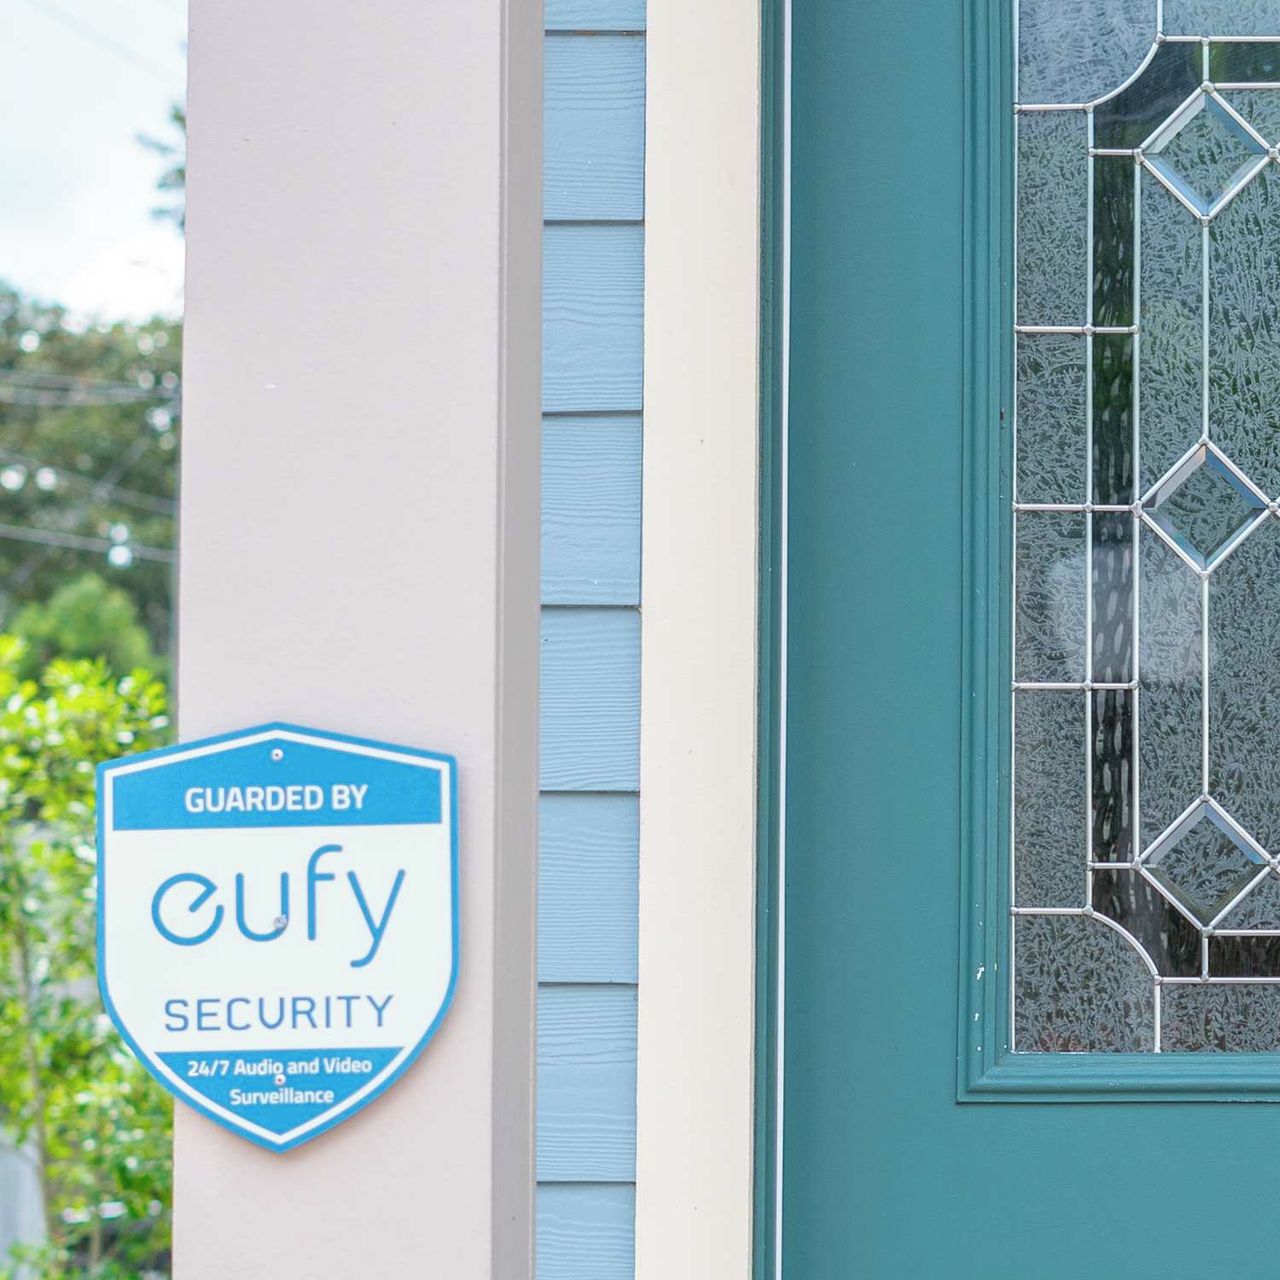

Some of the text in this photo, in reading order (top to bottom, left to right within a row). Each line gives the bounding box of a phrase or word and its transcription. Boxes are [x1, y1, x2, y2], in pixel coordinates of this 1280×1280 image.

[184, 783, 369, 813] GUARDED BY
[151, 844, 406, 968] eufy
[164, 995, 394, 1032] SECURITY
[187, 1058, 372, 1077] 24/7 Audio and Video
[230, 1088, 334, 1105] Surveillance
